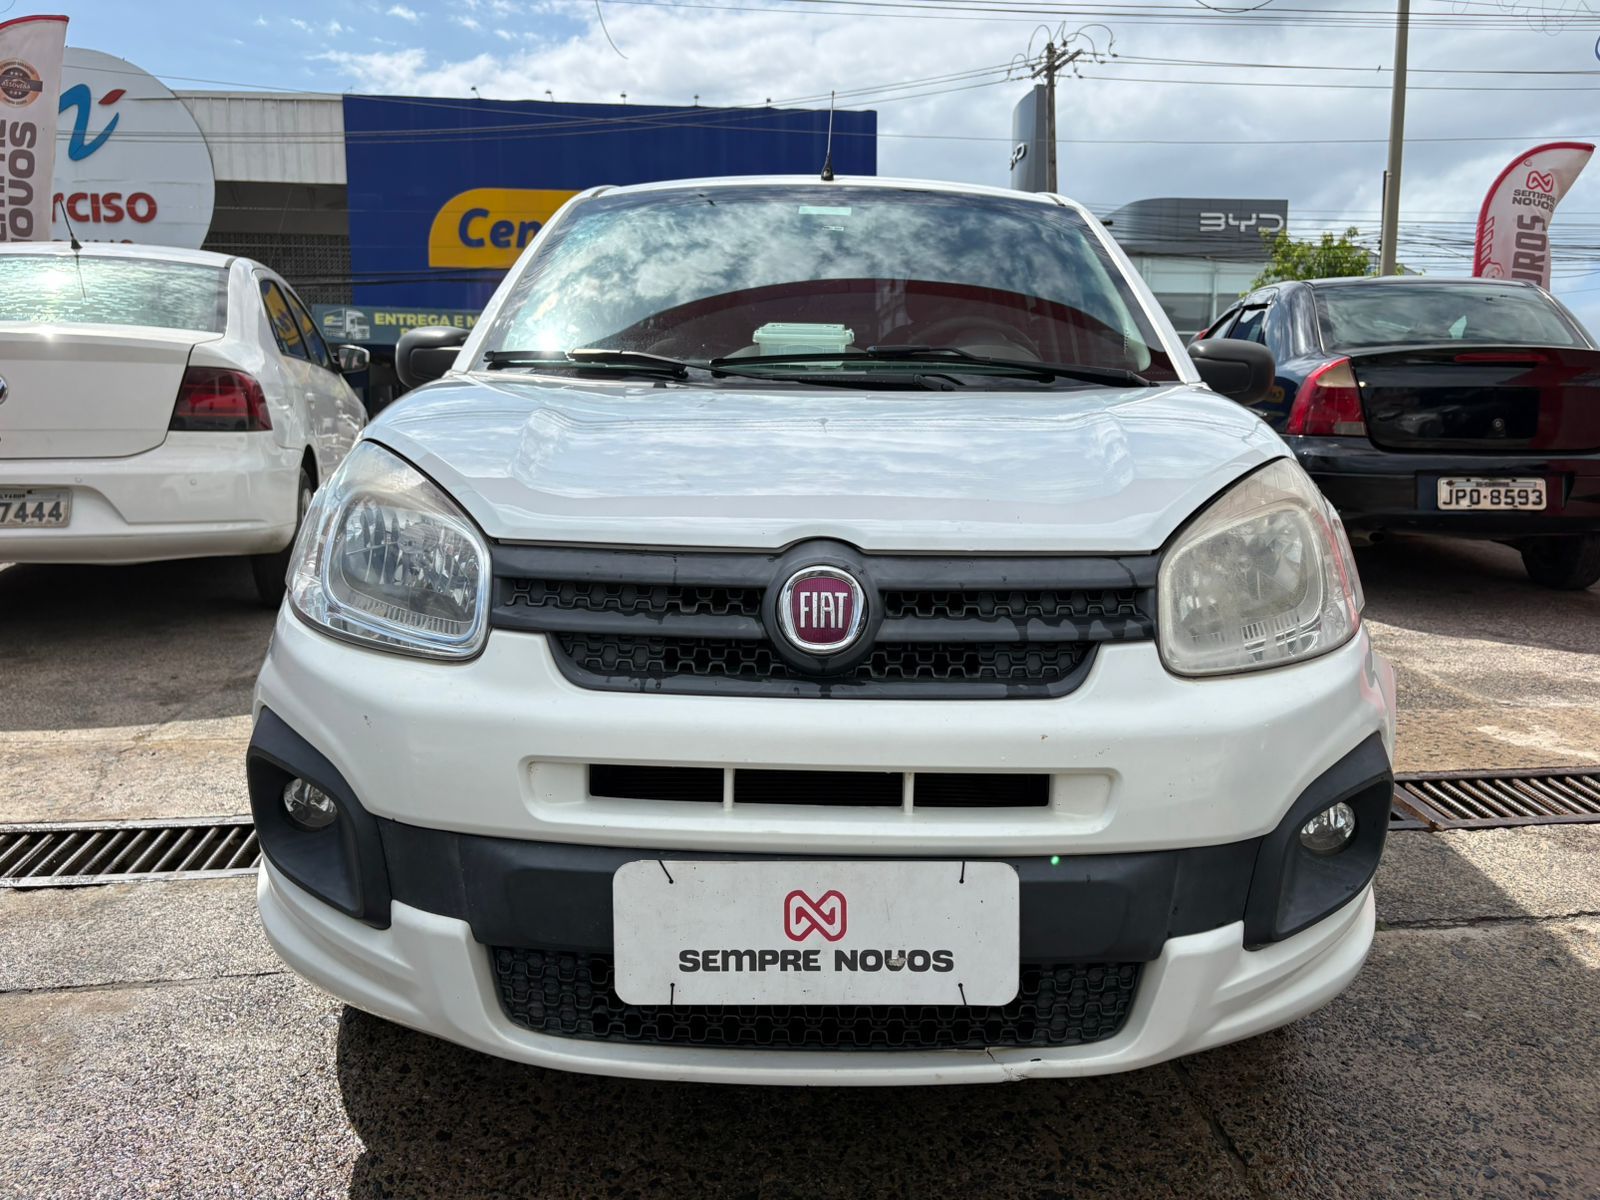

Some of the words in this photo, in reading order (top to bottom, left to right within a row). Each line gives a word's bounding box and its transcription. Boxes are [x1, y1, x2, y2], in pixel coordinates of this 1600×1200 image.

[1513, 189, 1556, 205] SEMPRE
[1200, 212, 1284, 232] BYD
[374, 312, 449, 327] ENTREGA
[453, 315, 464, 327] E
[0, 501, 62, 522] 7444
[799, 591, 849, 629] FIAT
[678, 949, 821, 972] SEMPRE
